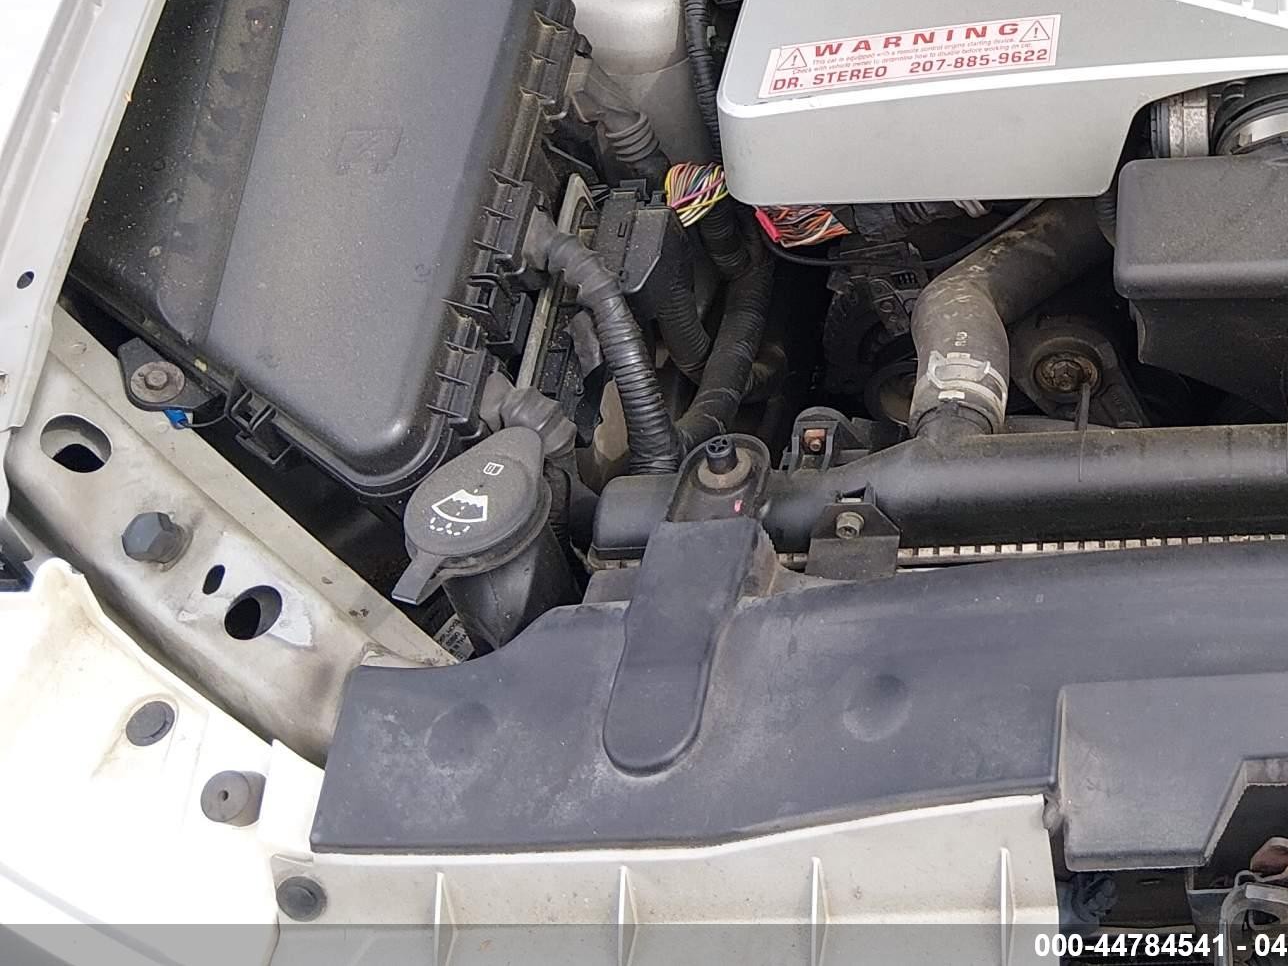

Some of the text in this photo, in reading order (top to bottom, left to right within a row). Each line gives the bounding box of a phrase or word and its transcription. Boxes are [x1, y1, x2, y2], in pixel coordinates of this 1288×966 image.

[815, 22, 1019, 57] WARNING
[846, 53, 875, 62] equipped
[920, 44, 942, 52] control
[967, 39, 992, 48] starting
[984, 44, 1009, 53] working
[772, 48, 1049, 91] DR. STEREO 207-885-9622
